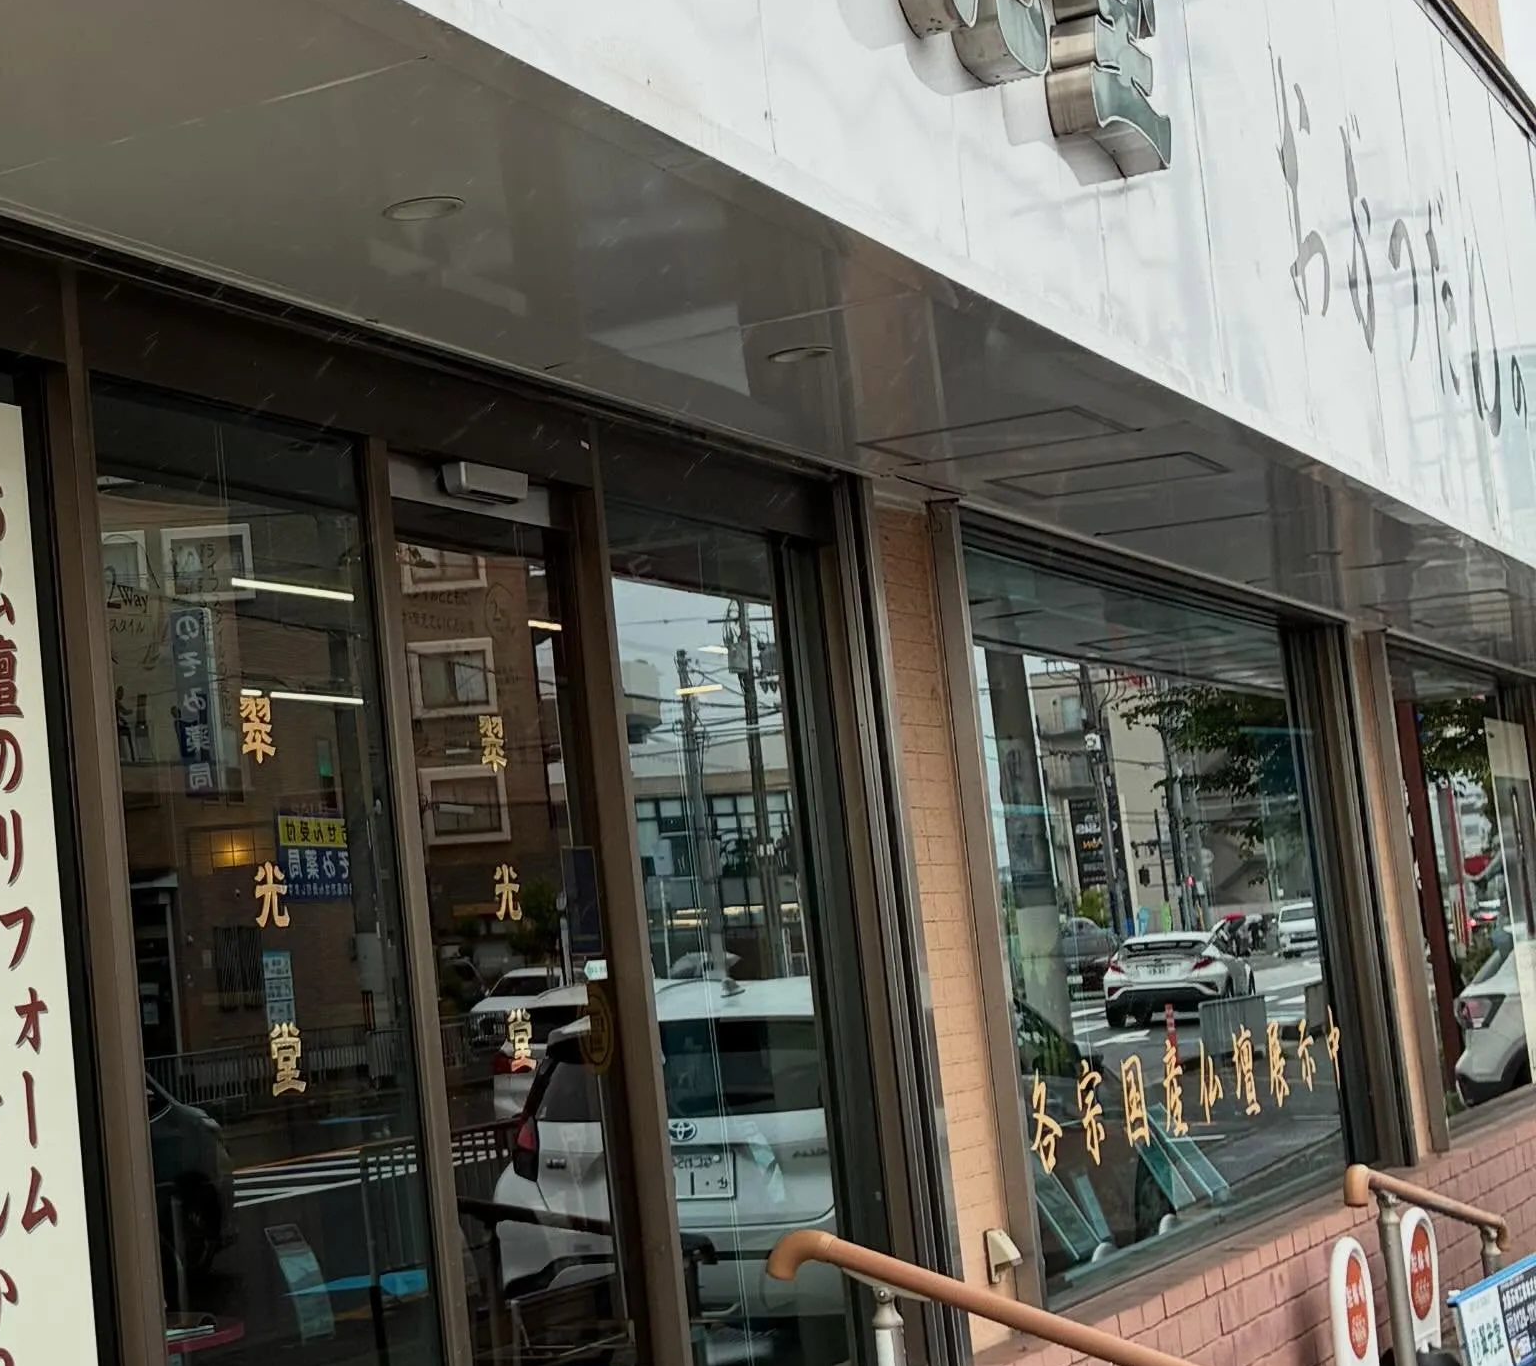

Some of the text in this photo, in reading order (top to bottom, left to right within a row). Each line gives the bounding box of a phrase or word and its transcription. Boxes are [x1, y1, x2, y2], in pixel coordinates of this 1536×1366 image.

[239, 696, 307, 1097] 翠光堂
[479, 715, 537, 1072] 翠光堂
[1031, 1005, 1341, 1175] 各宗国産仏壇展示中
